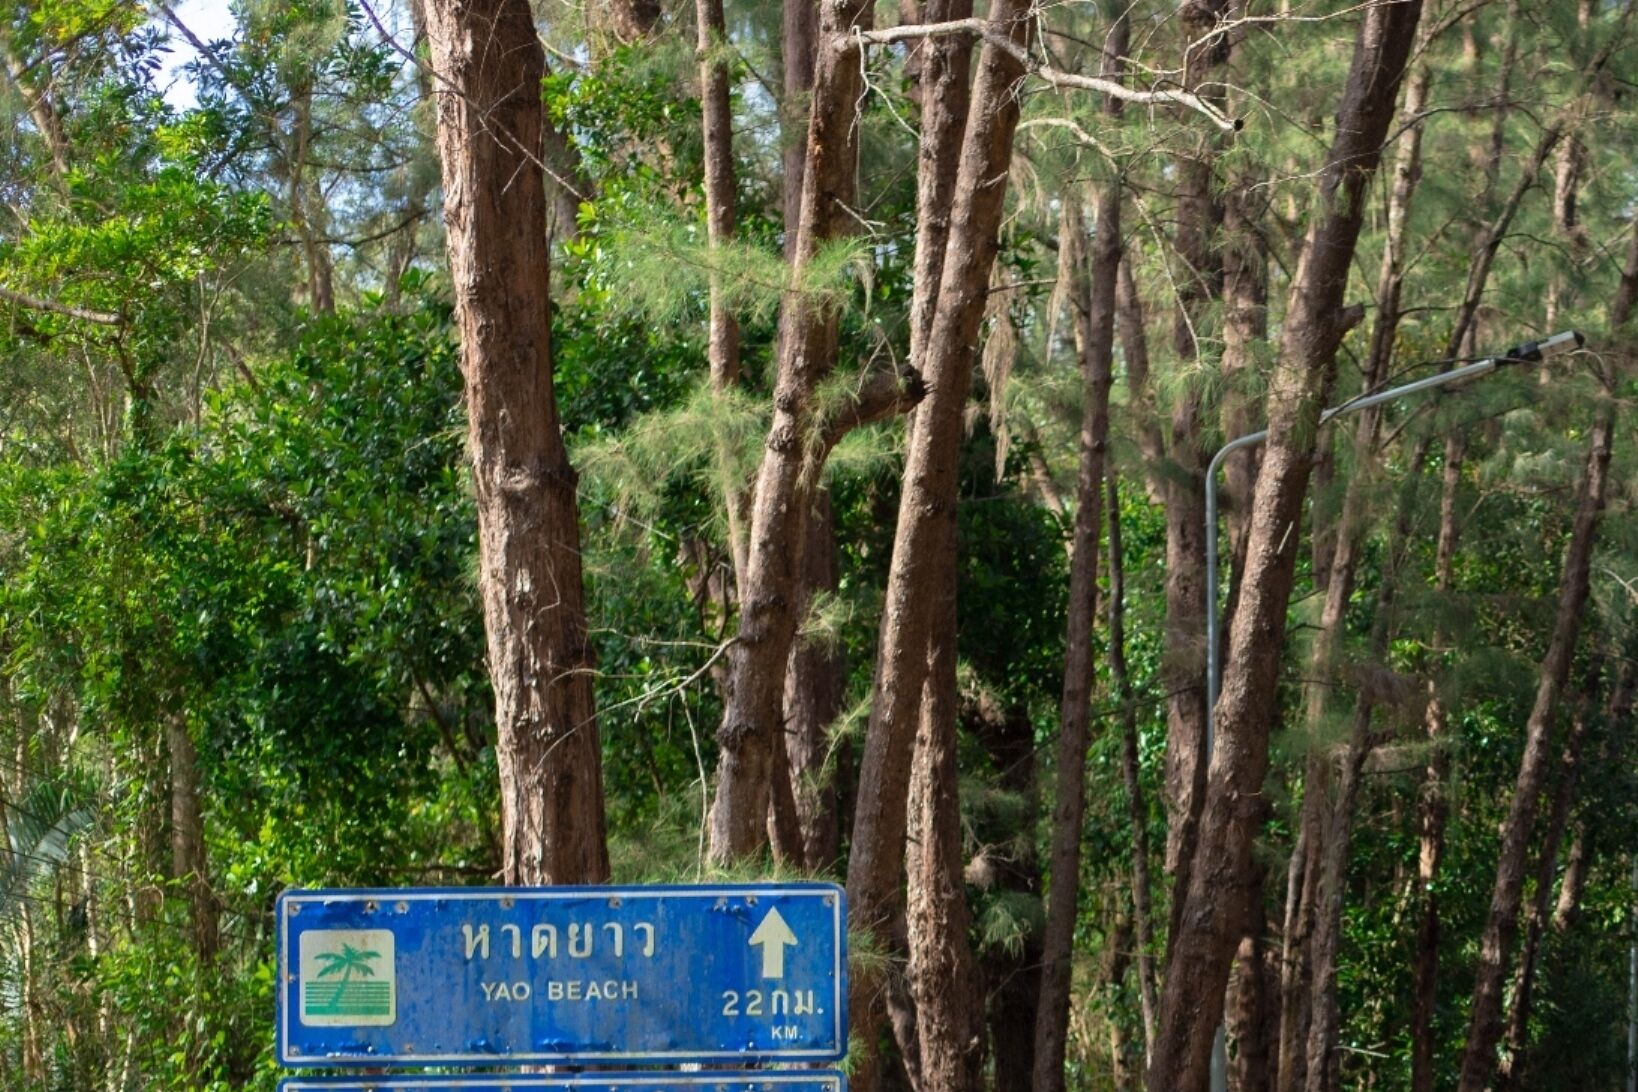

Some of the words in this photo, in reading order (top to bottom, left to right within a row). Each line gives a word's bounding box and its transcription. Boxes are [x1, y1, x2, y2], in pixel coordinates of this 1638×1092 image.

[461, 922, 656, 960] หาดยาว
[481, 982, 530, 1002] YAO
[548, 980, 639, 1001] BEACH
[771, 1025, 804, 1041] KM.
